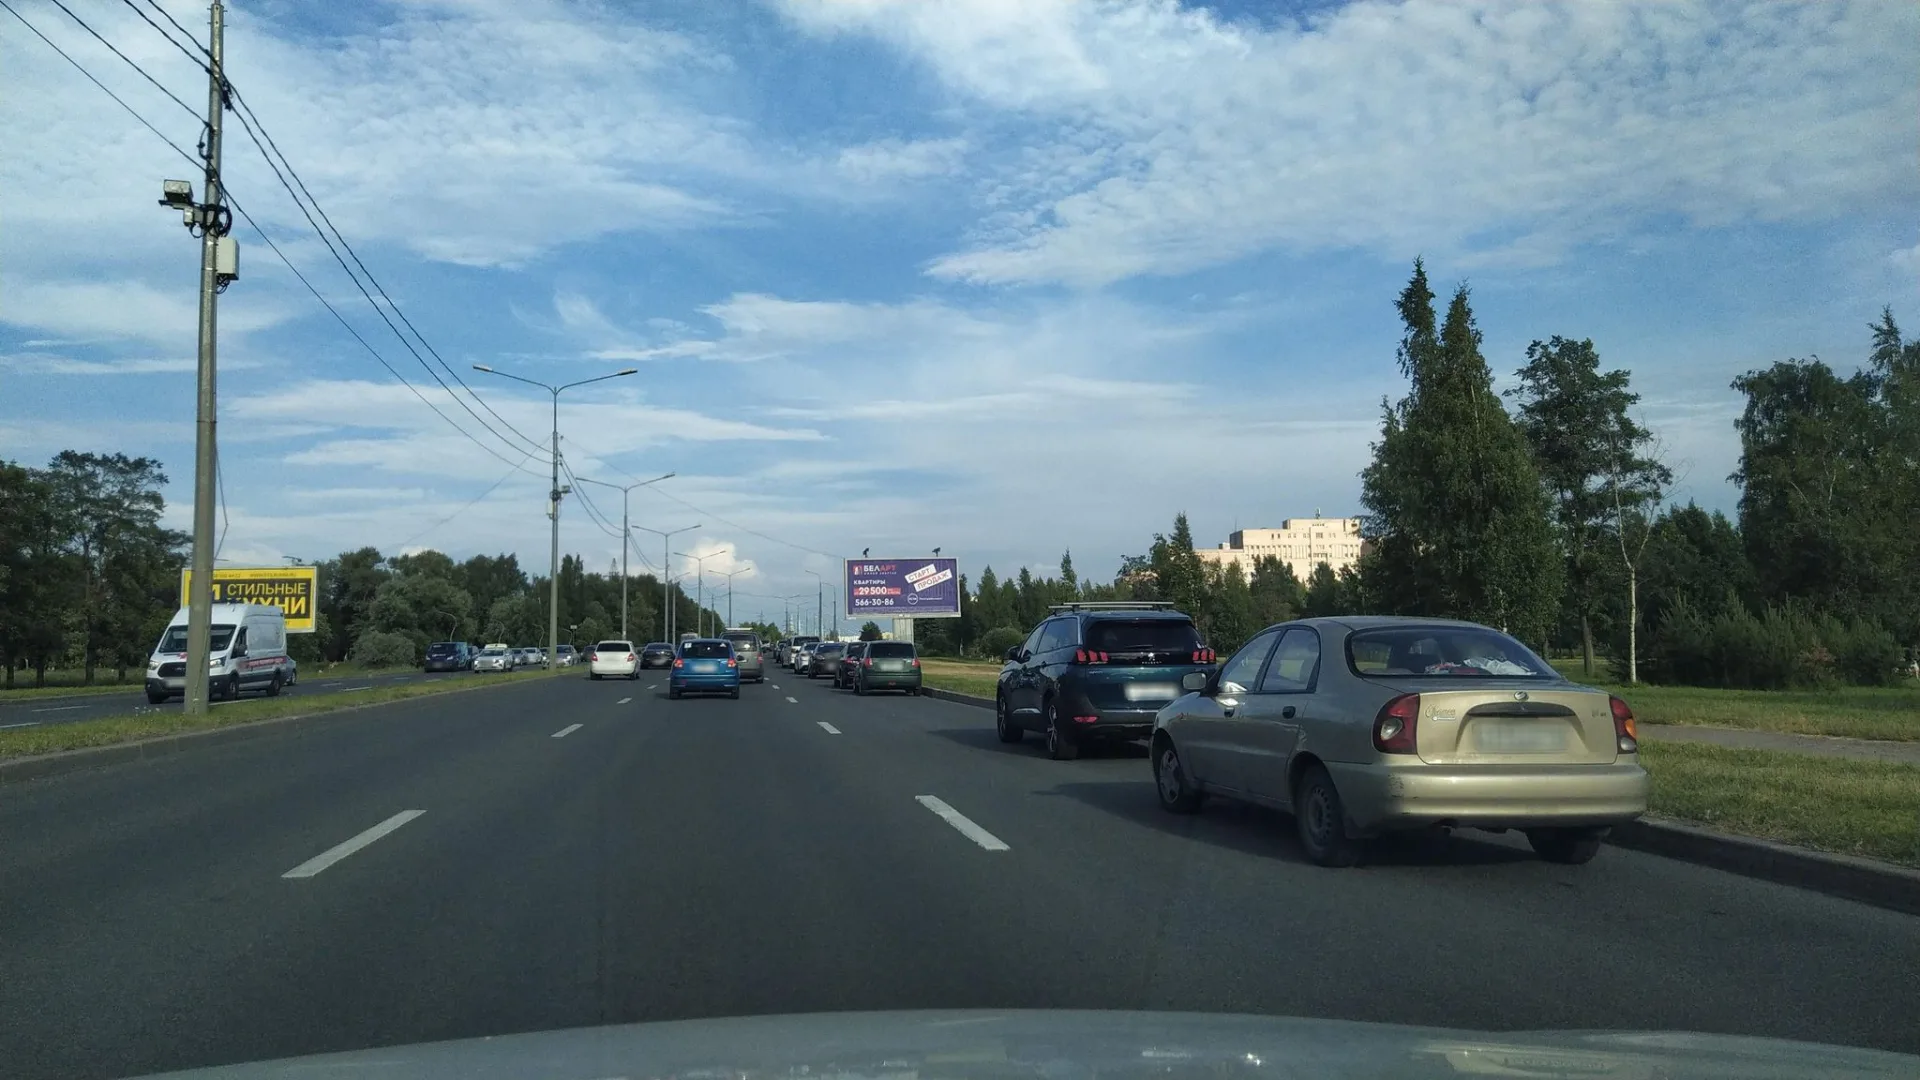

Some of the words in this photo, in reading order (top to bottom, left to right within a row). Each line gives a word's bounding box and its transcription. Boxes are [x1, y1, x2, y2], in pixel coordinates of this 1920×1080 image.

[863, 564, 897, 572] БЕЛАРТ
[908, 568, 930, 581] СТАРТ
[917, 571, 949, 589] ПРОДАЖ
[227, 583, 306, 595] СТИЛЬНЫЕ
[227, 597, 306, 614] ХНИ
[855, 598, 894, 606] 566-30-86
